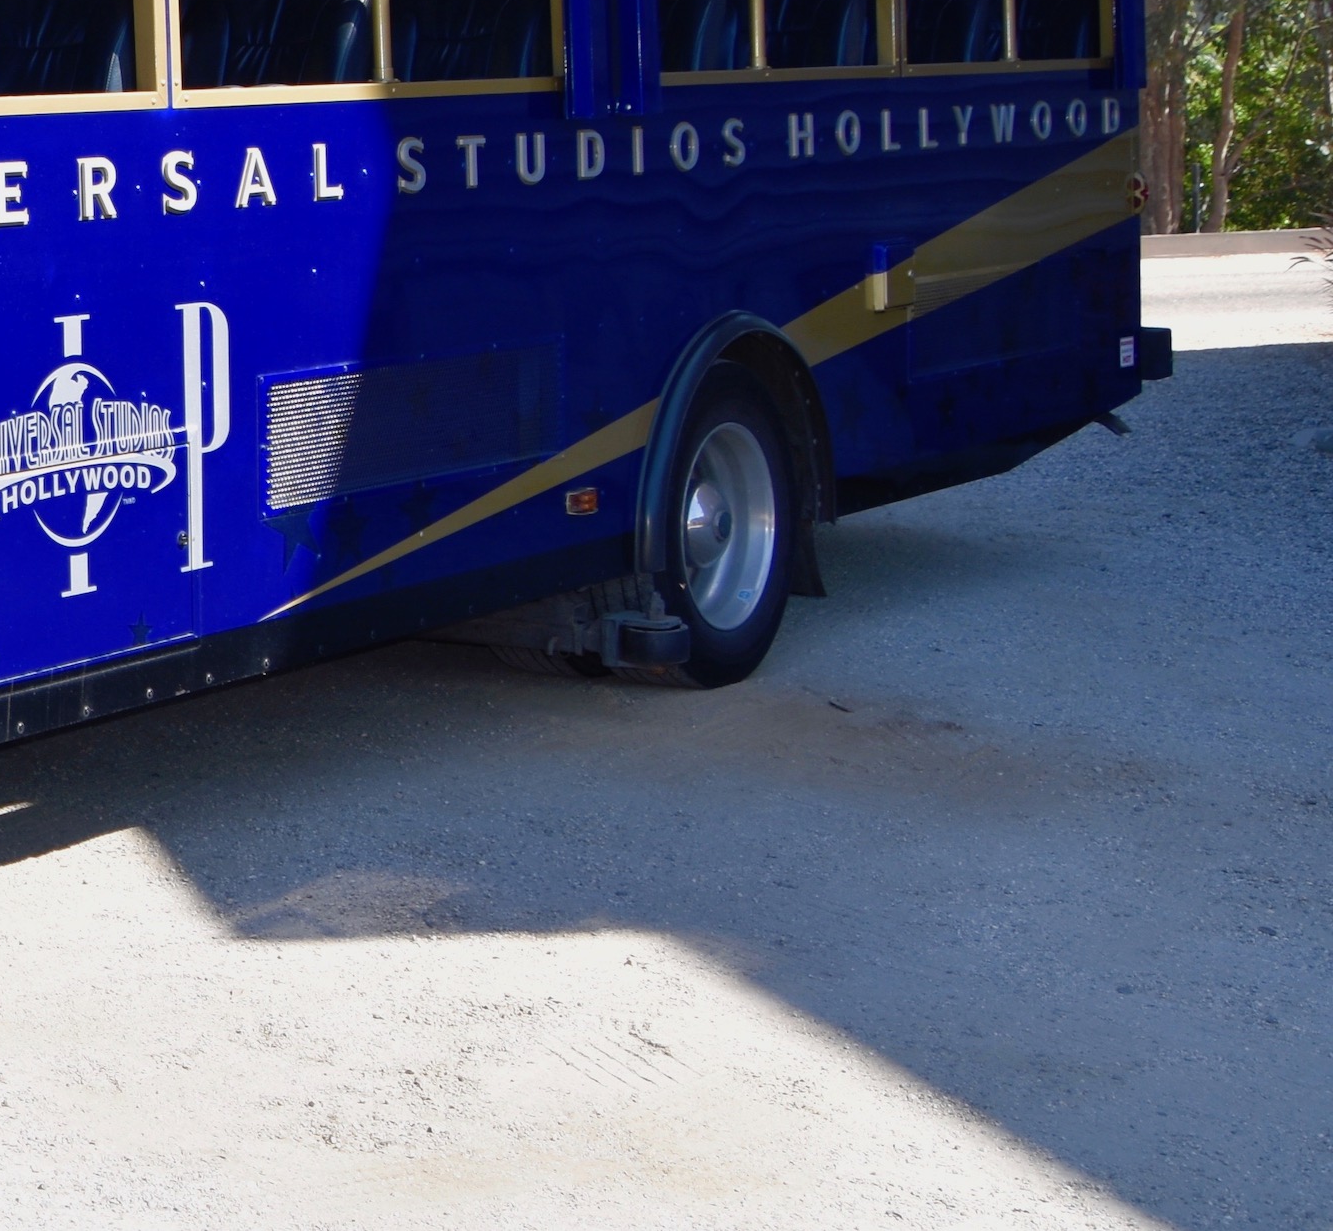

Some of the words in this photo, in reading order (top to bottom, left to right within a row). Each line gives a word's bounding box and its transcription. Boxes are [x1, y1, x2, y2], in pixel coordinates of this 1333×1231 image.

[396, 118, 746, 193] STUDIOS
[788, 96, 1120, 158] HOLLYWOOD
[90, 398, 176, 462] STUDIOS
[1, 465, 152, 514] HOLLYWOOD
